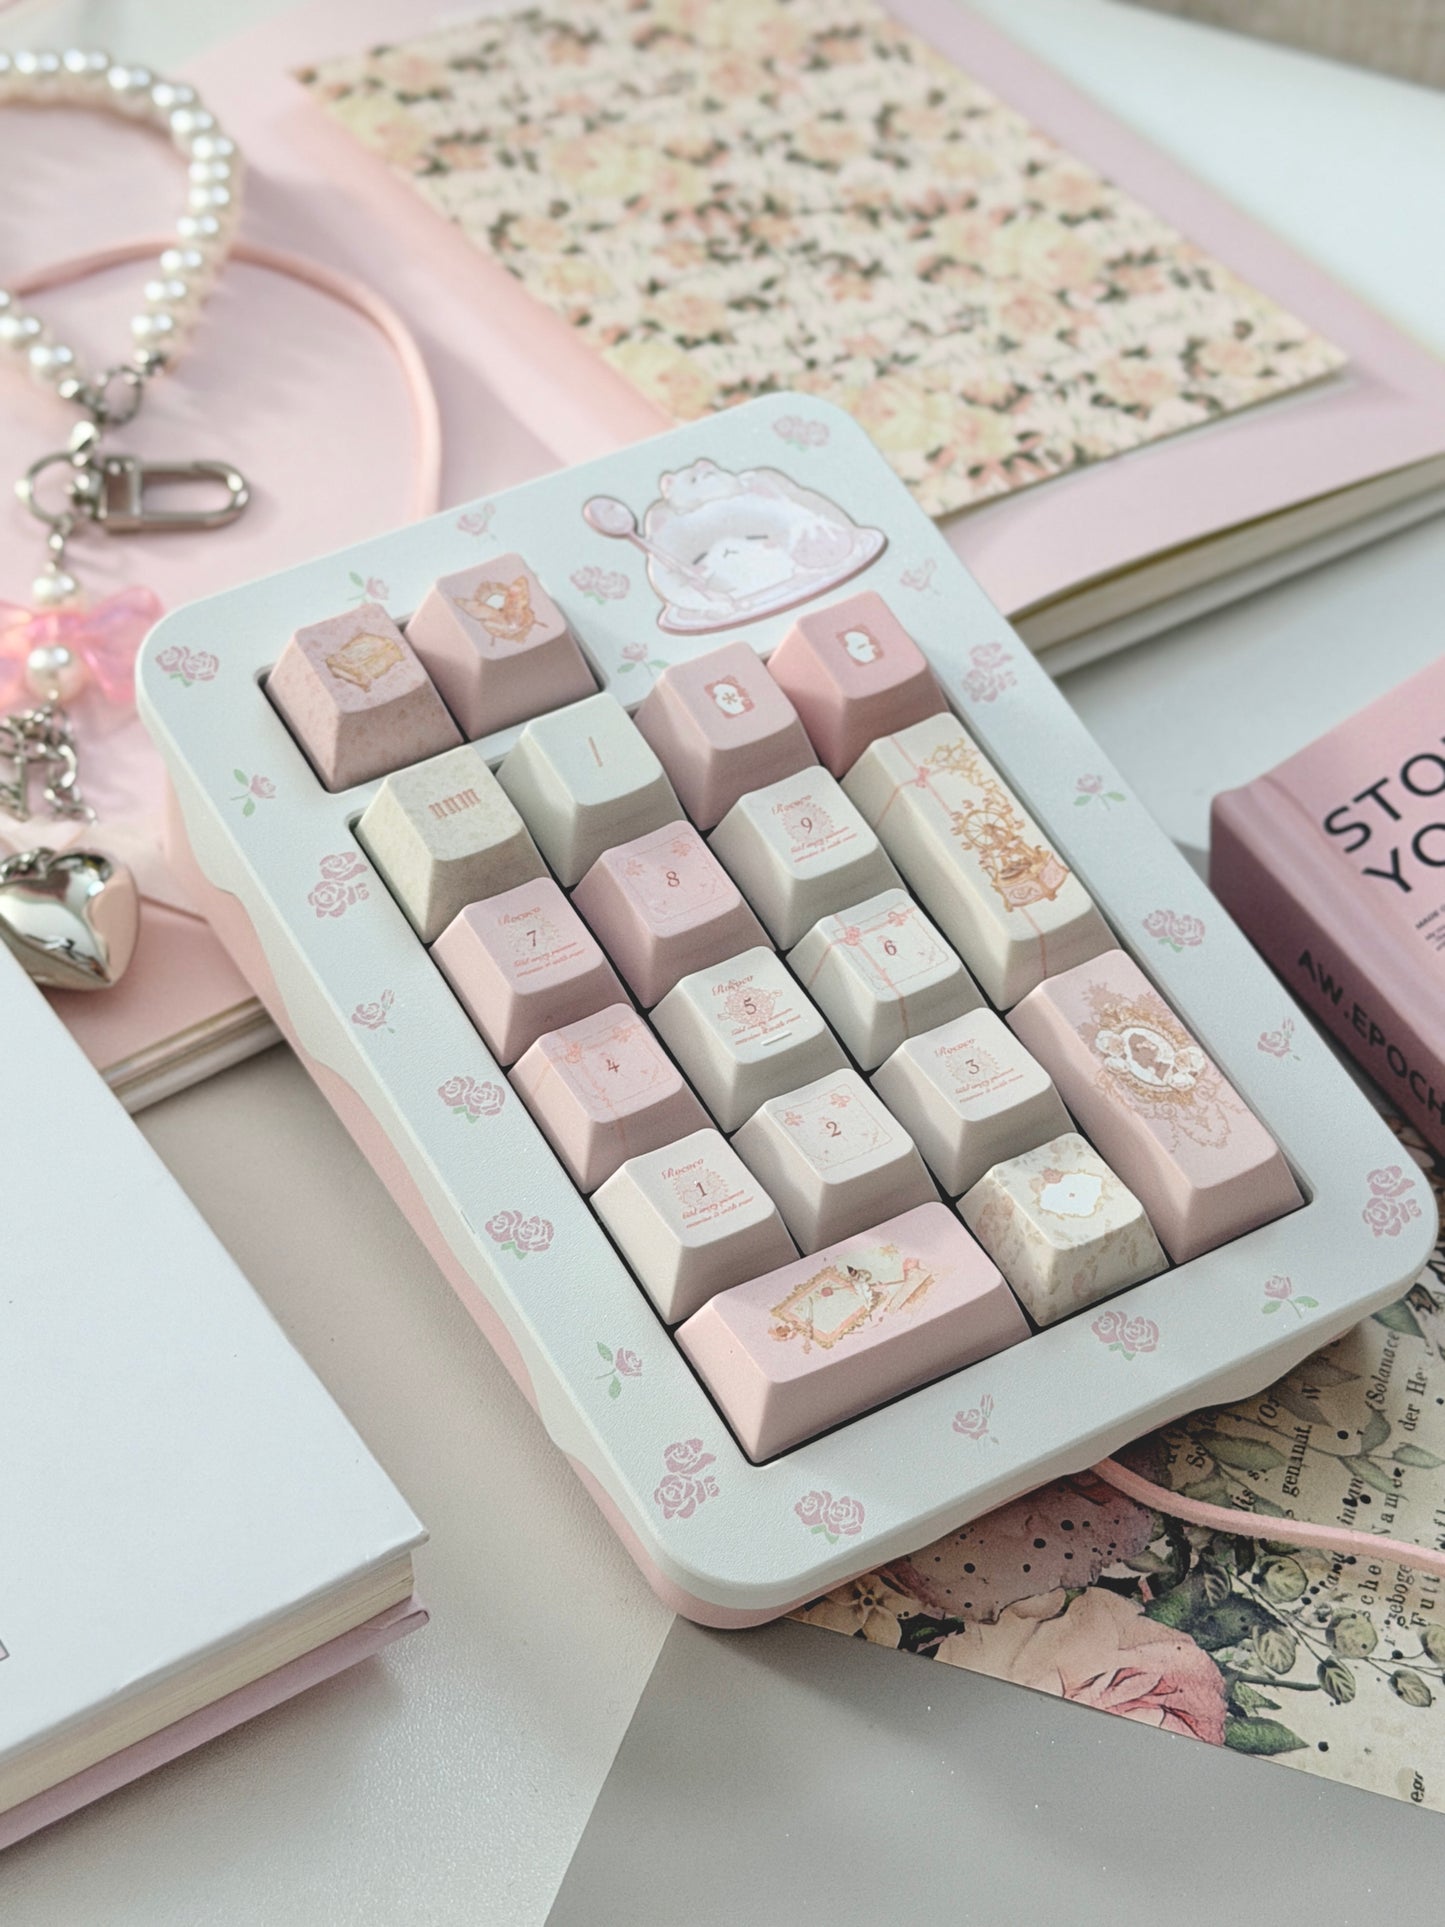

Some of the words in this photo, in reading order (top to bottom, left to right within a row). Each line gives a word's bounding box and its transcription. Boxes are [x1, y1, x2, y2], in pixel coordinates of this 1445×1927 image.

[1323, 736, 1445, 855] STO
[800, 817, 813, 834] 9
[666, 871, 681, 887] 8
[526, 930, 537, 947] 7
[884, 940, 897, 956] 6
[744, 998, 757, 1015] 5
[607, 1058, 620, 1073] 4
[965, 1059, 980, 1075] 3
[826, 1121, 841, 1137] 2
[696, 1182, 707, 1197] 1
[1398, 1404, 1420, 1431] der
